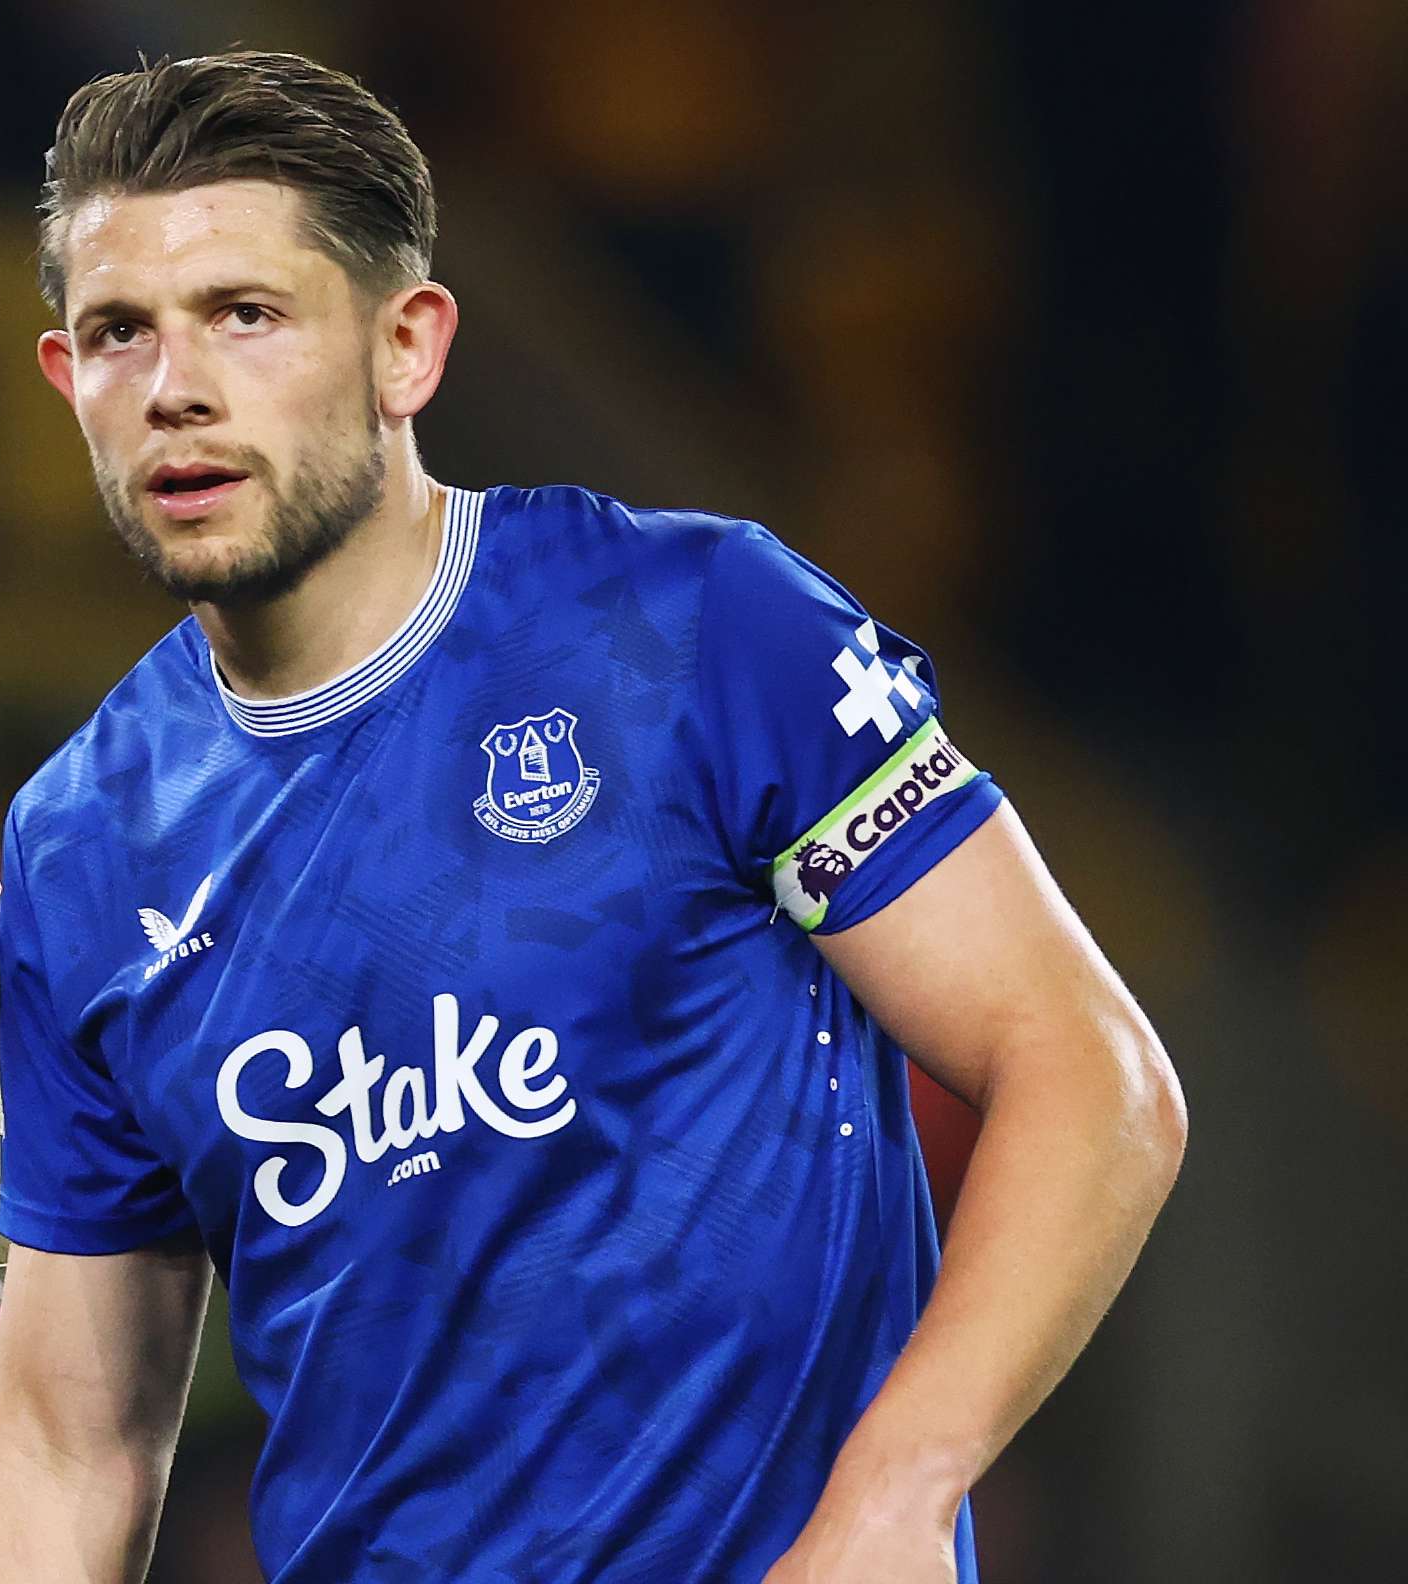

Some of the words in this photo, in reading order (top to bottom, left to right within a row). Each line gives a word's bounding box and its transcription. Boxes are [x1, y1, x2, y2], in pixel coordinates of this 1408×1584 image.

[483, 812, 500, 829] NIL
[558, 786, 595, 830] OPTIMUM
[504, 781, 573, 809] Everton
[846, 736, 963, 852] Captai
[216, 993, 577, 1227] Stake
[387, 1150, 441, 1187] .com
